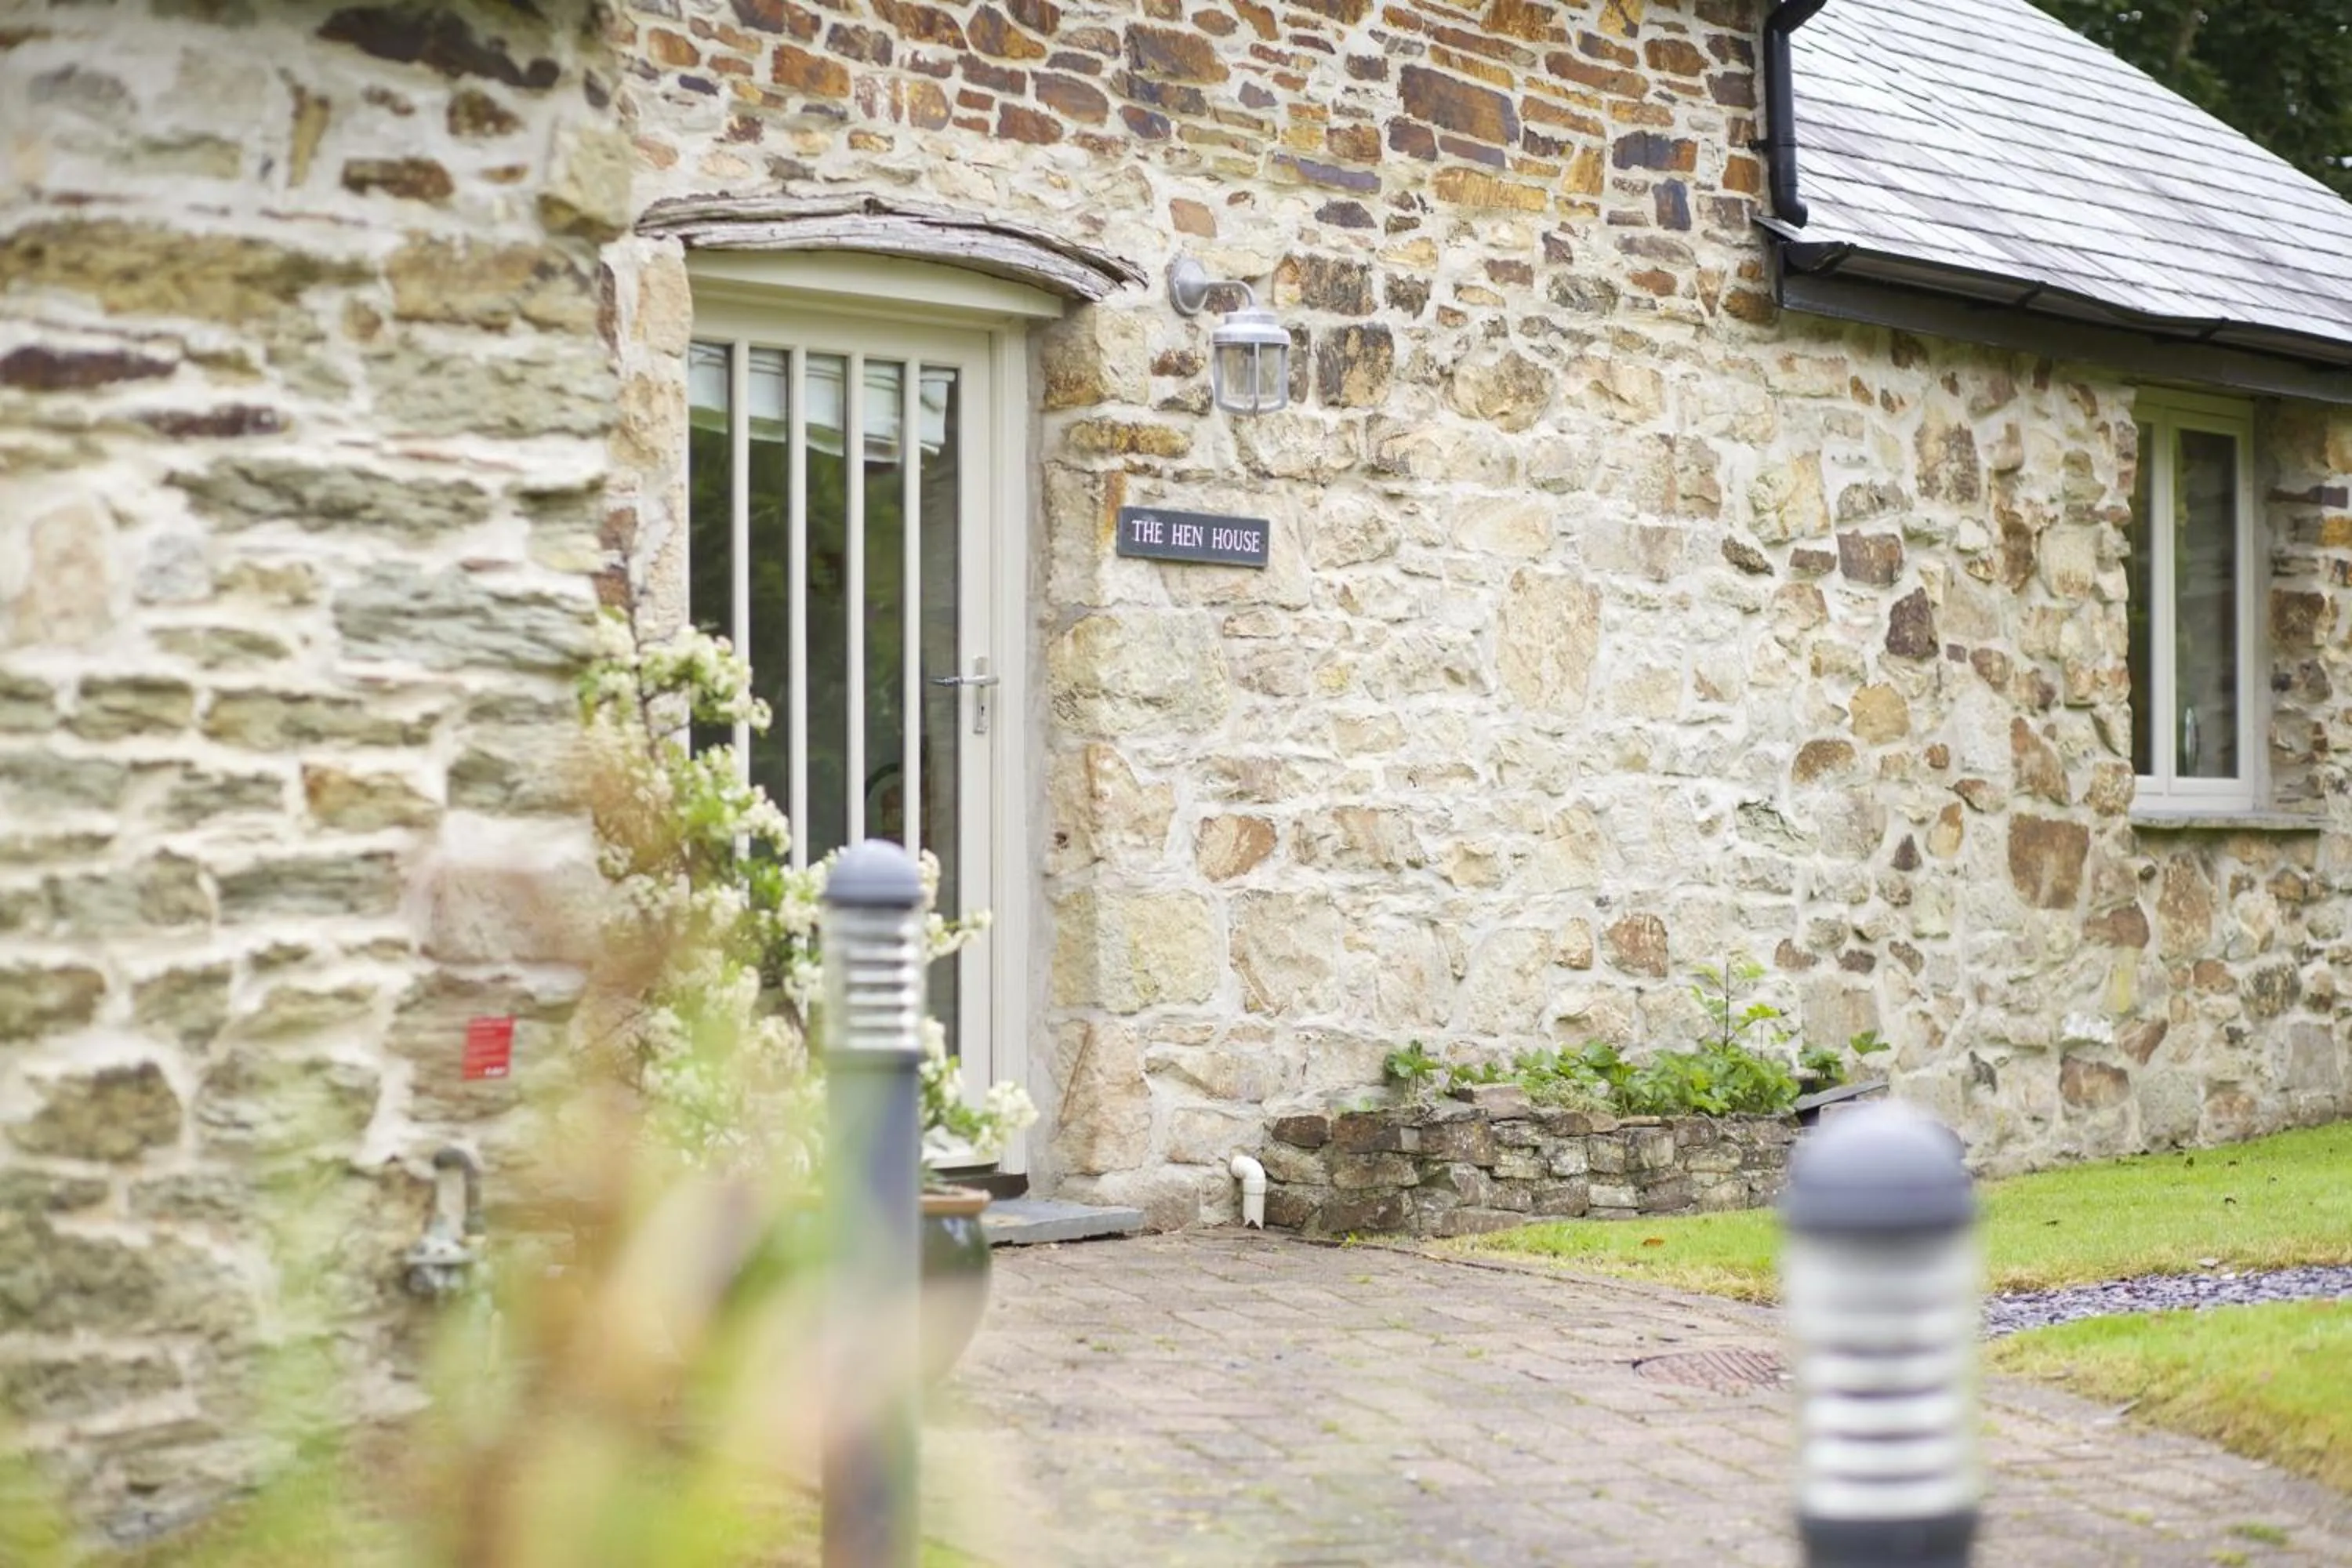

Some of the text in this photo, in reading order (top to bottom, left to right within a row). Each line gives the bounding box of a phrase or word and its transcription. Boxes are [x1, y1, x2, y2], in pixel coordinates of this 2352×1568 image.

[1131, 520, 1261, 553] THE HEN HOUSE
